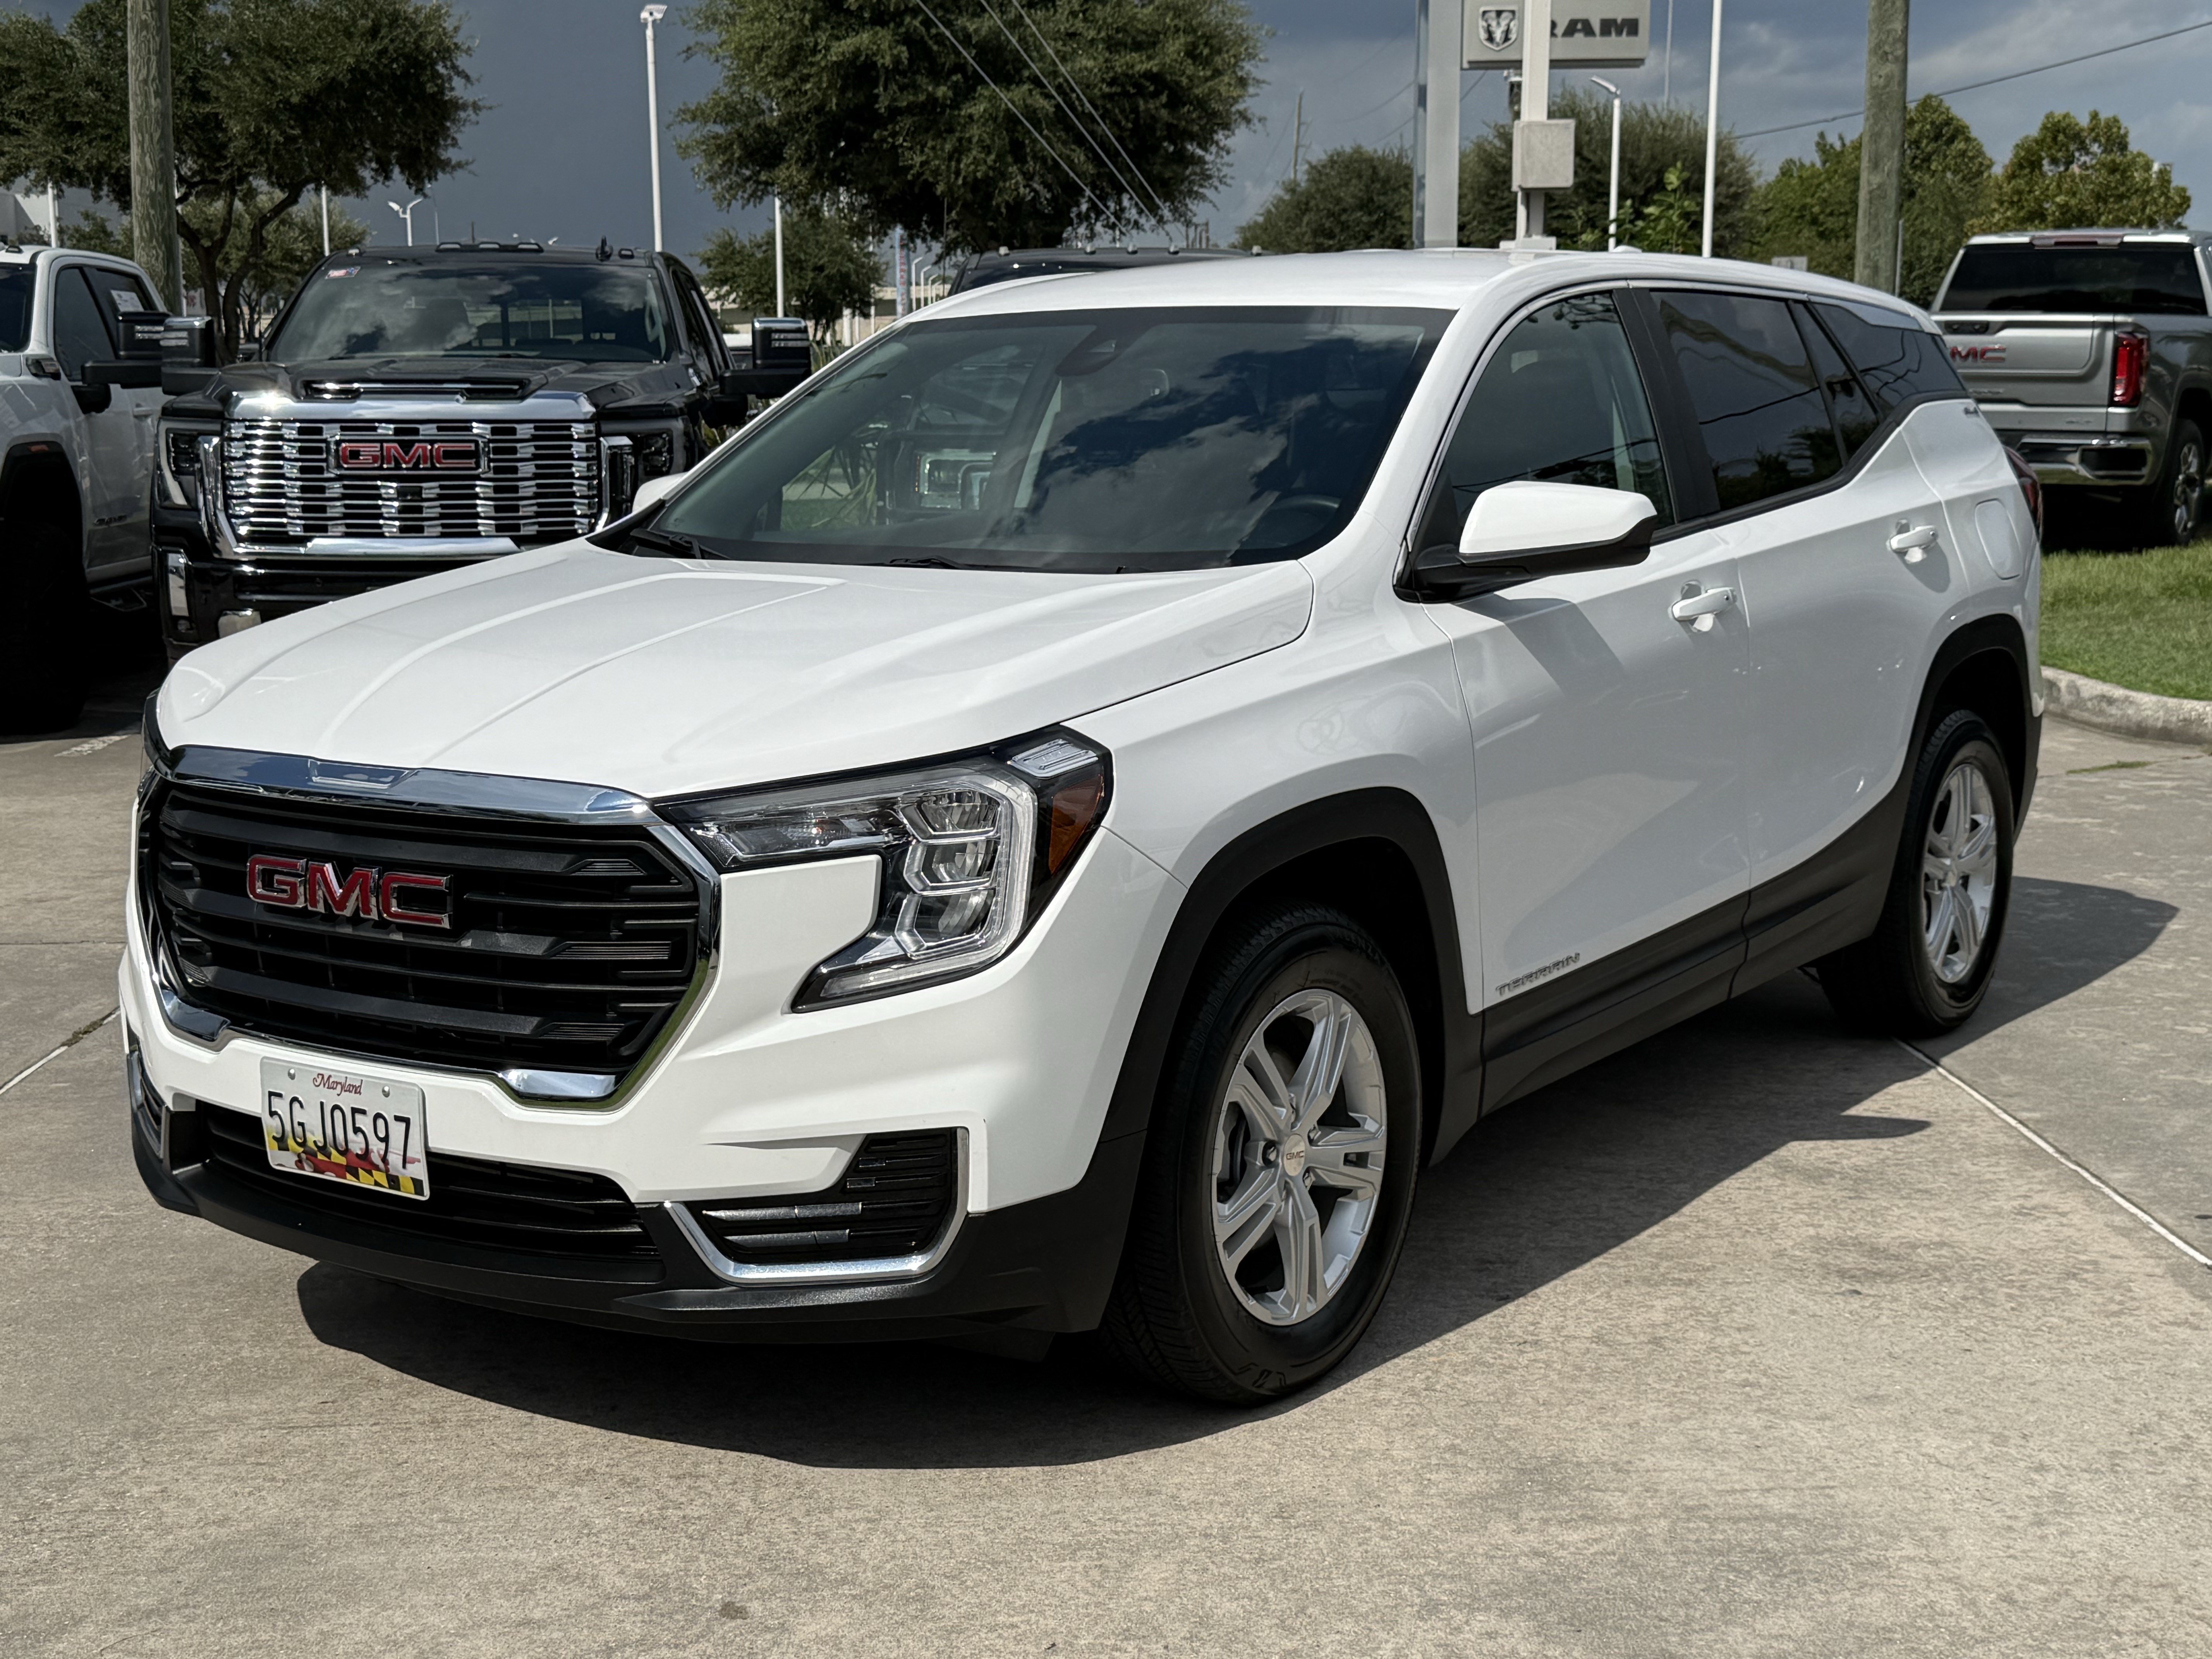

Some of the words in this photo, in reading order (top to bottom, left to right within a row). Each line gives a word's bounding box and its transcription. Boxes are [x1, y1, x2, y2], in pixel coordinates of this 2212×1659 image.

[1551, 18, 1639, 38] AM
[1950, 345, 2006, 362] MC
[340, 442, 476, 468] GMC
[246, 854, 453, 929] GMC
[1495, 951, 1580, 996] TERRAIN
[313, 1073, 363, 1096] Maryland
[268, 1090, 411, 1170] 5GJ0597
[1286, 1151, 1304, 1160] GMC
